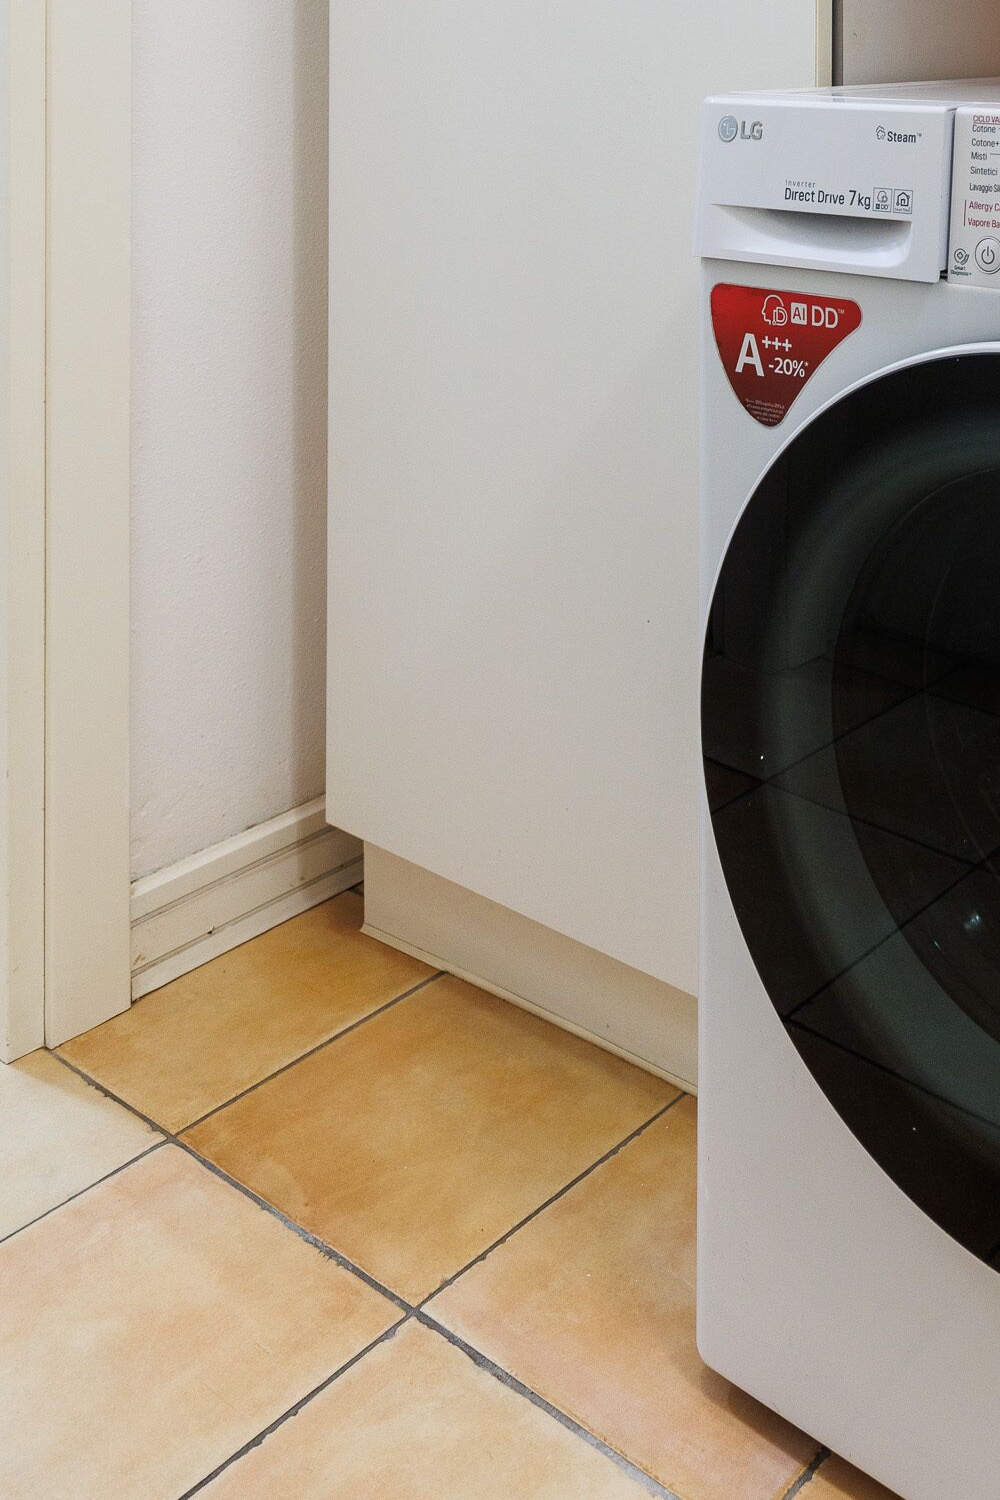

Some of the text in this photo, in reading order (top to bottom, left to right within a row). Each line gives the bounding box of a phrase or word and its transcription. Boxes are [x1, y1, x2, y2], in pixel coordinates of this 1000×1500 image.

[973, 115, 991, 123] CICLO
[740, 120, 763, 140] LG
[972, 124, 997, 134] Cotone
[971, 138, 1000, 148] Cotone+
[970, 151, 988, 160] Misti
[970, 165, 998, 176] Sintetici
[785, 180, 816, 188] Inverter
[969, 182, 993, 193] Lavaggio
[784, 187, 816, 203] Direct
[817, 190, 845, 205] Drive
[968, 200, 993, 212] Allergy
[968, 217, 991, 228] Vapore
[792, 305, 806, 322] AI
[735, 332, 793, 377] A+++
